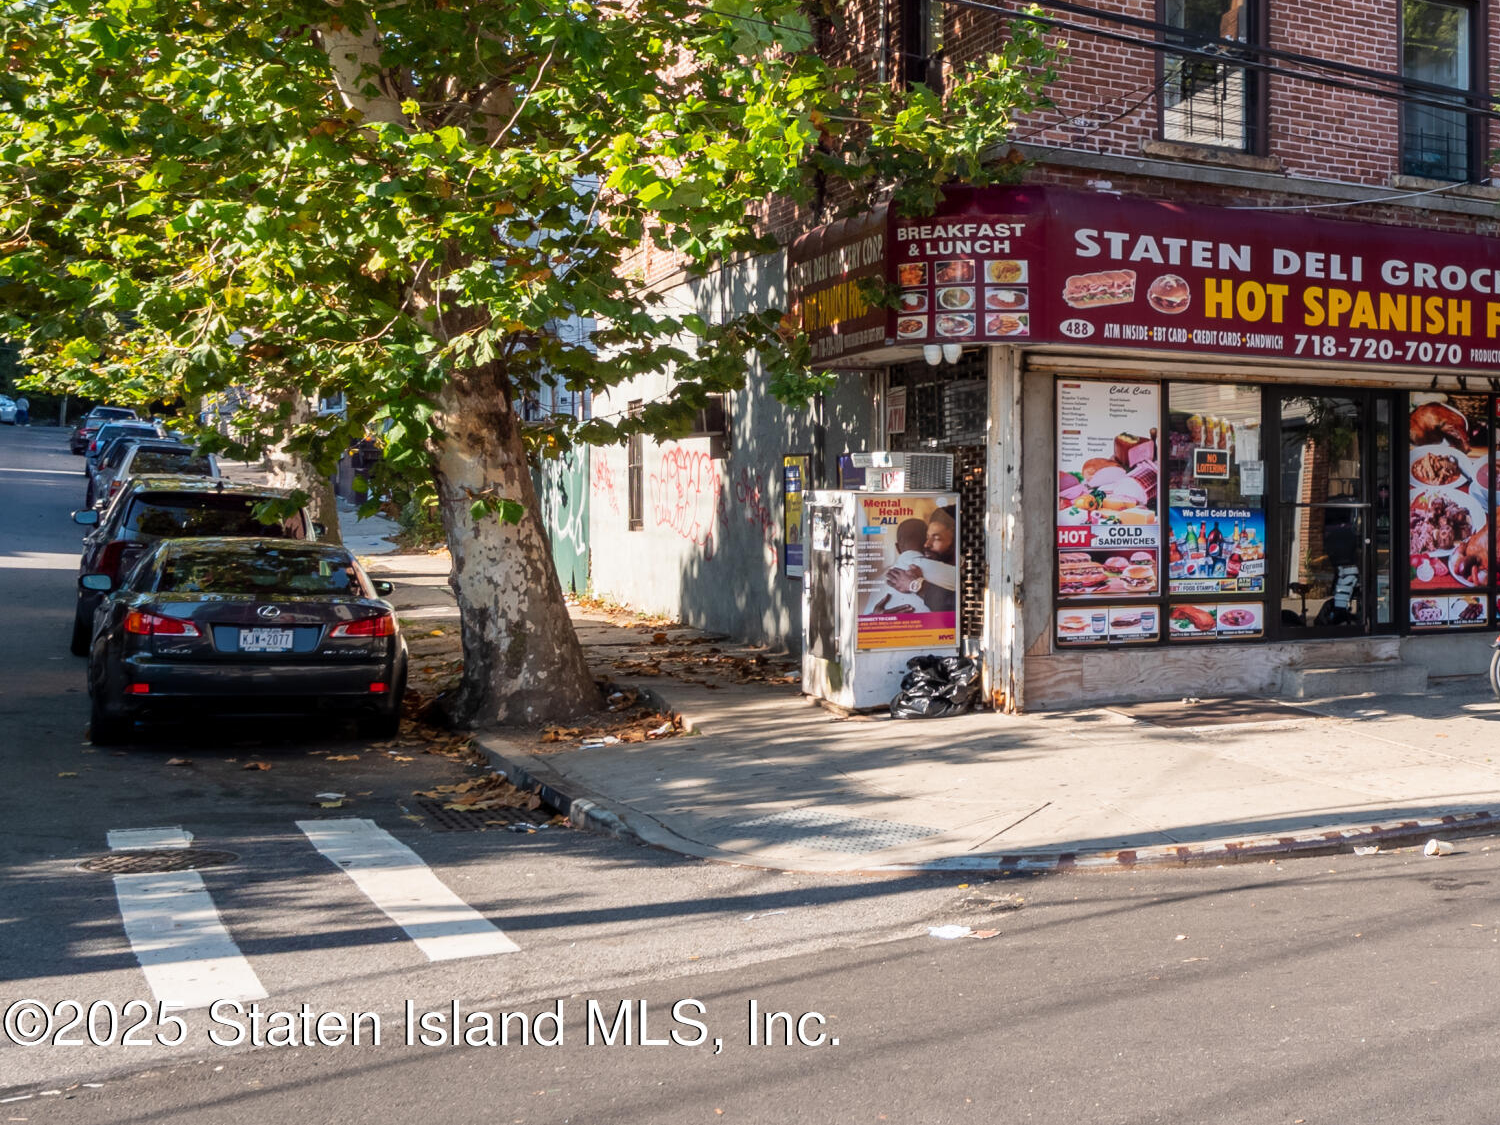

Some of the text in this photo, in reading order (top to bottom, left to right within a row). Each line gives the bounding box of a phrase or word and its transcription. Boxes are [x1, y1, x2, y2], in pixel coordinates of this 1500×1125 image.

[897, 223, 1026, 241] BREAKFAST
[908, 240, 1010, 257] & LUNCH
[1074, 228, 1251, 272] STATEN
[1272, 248, 1362, 283] DELI
[1204, 277, 1289, 324] HOT
[1303, 286, 1472, 337] SPANISH
[1066, 322, 1088, 336] 488
[1104, 323, 1284, 350] ATM INSIDE EBT CARD CREDIT CARDS SANDWICH
[1294, 334, 1462, 364] 718-720-7070
[1109, 385, 1151, 396] Cold Cuts
[1207, 453, 1217, 463] NO
[1197, 463, 1227, 474] LOITERING
[864, 499, 901, 508] Mental
[879, 507, 914, 517] Health
[1182, 509, 1251, 518] We Sell Cold Drinks
[880, 517, 898, 525] ALL
[1059, 530, 1088, 544] HOT
[1108, 527, 1143, 537] COLD
[1098, 537, 1156, 546] SANDWICHES
